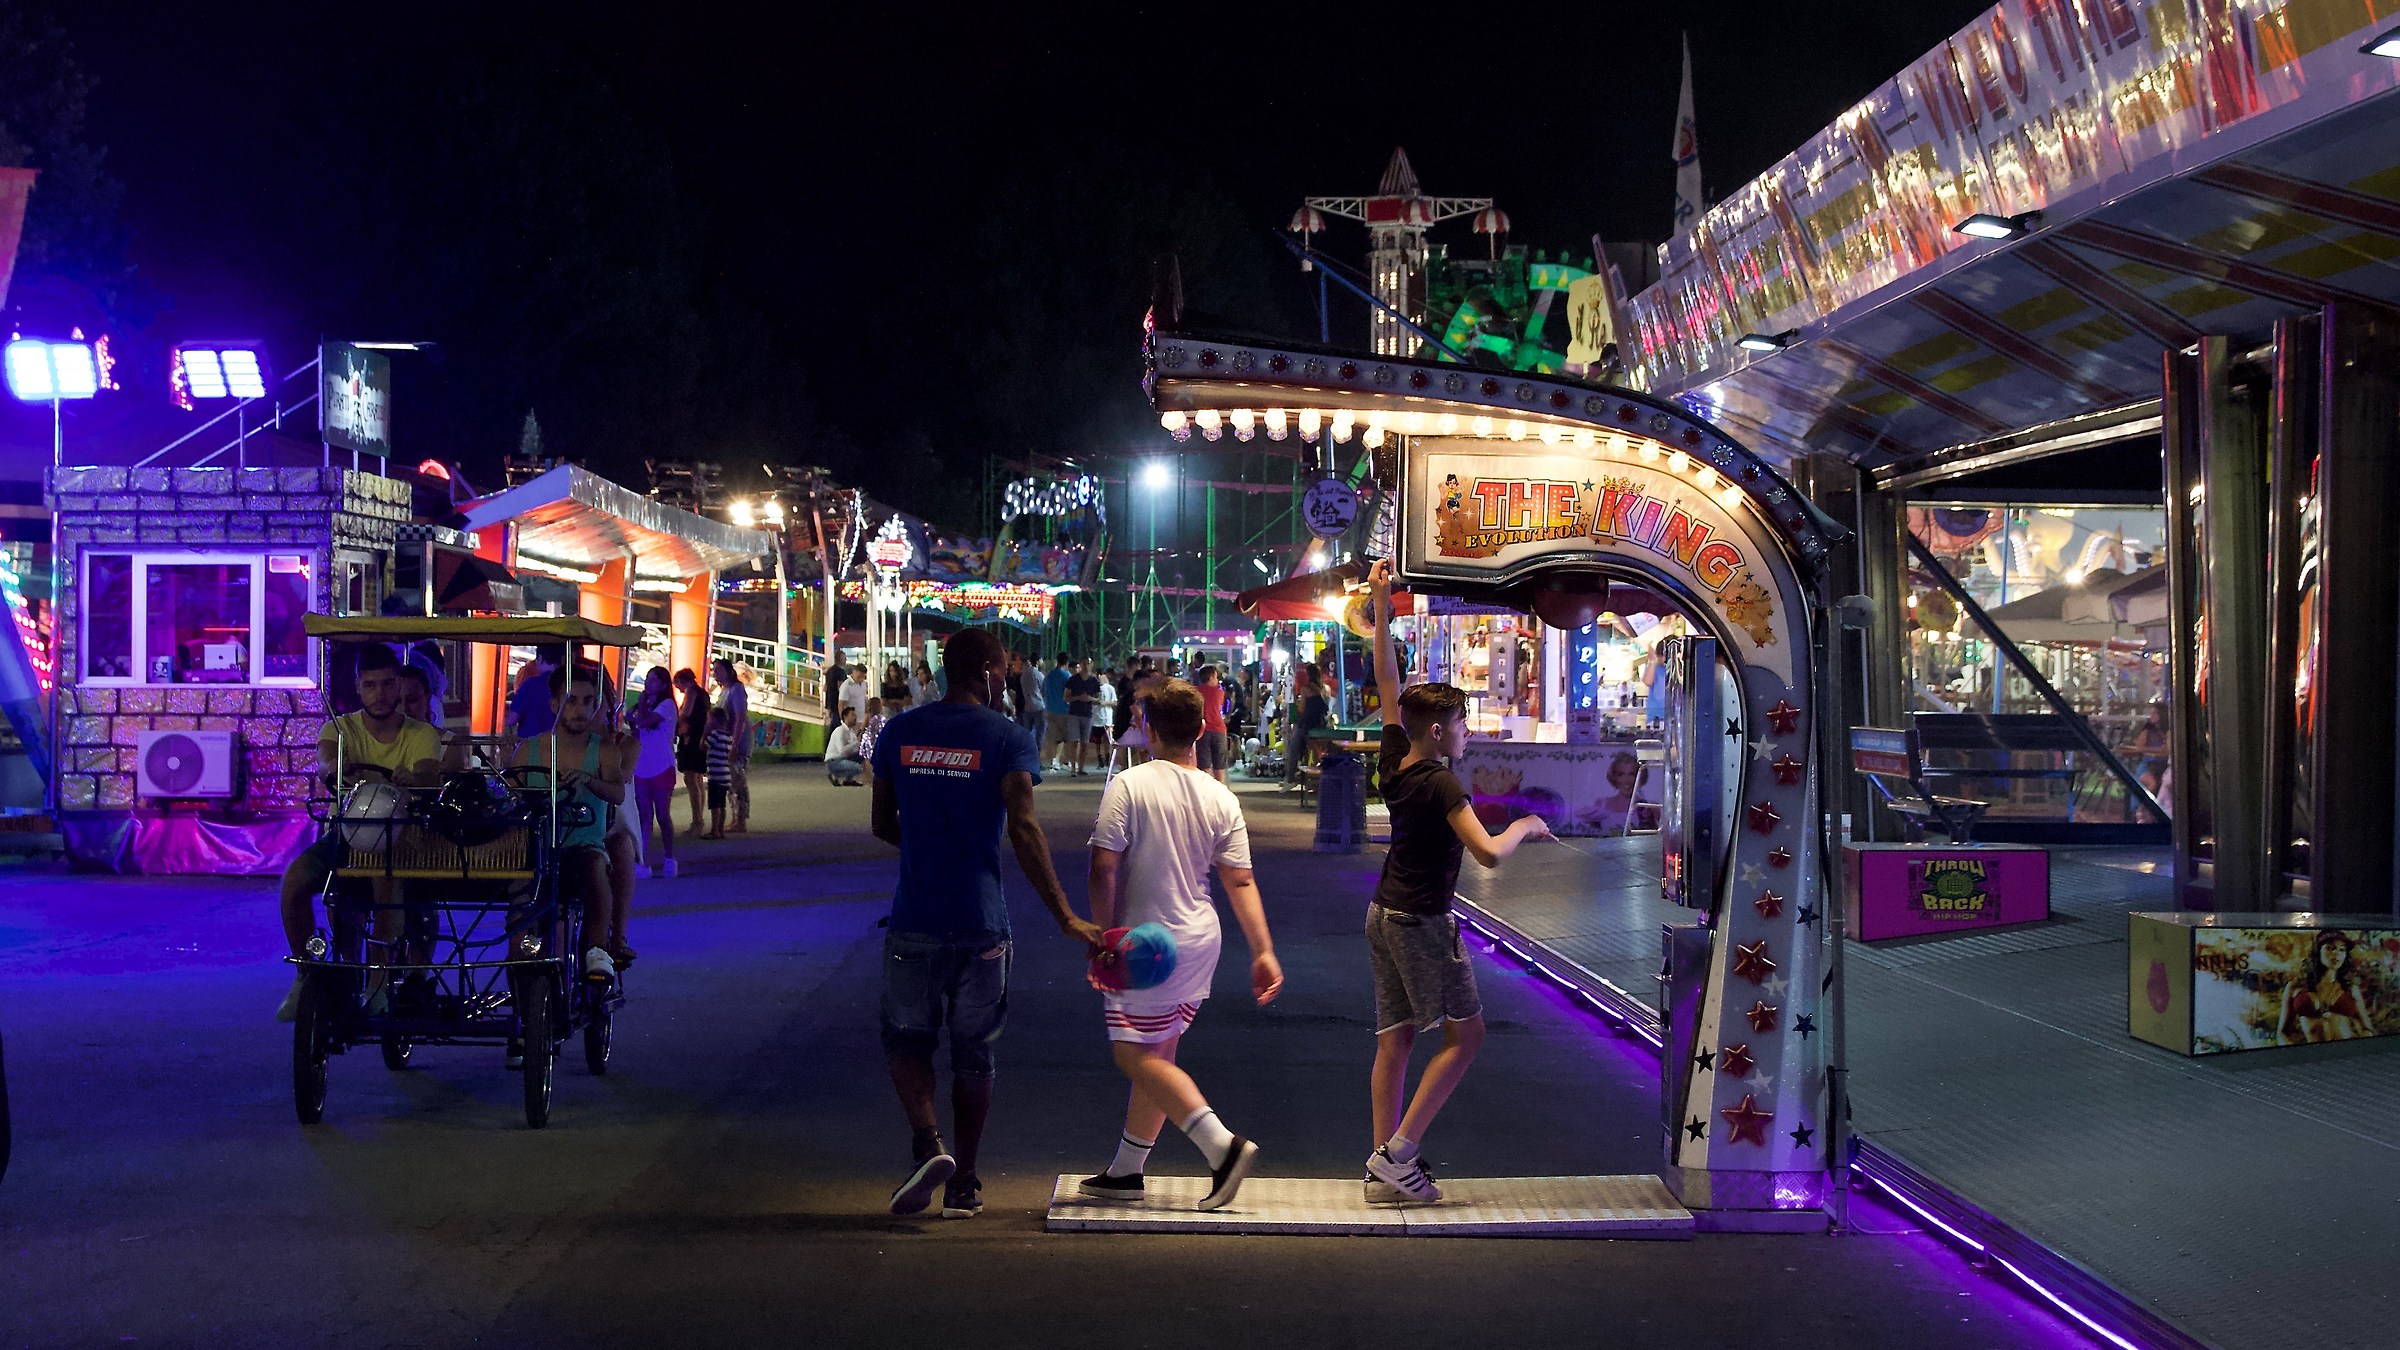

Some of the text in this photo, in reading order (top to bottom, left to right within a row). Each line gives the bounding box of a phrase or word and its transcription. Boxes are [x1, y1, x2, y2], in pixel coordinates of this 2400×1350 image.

[1464, 523, 1587, 549] EVOLUTION
[1471, 477, 1747, 593] THE KING
[752, 720, 792, 747] USIC
[910, 749, 973, 767] RAPIDO
[909, 767, 935, 775] IMPRESA
[946, 769, 971, 778] SERVIZI
[1924, 860, 1986, 878] THROW
[1921, 893, 1986, 910] BACK
